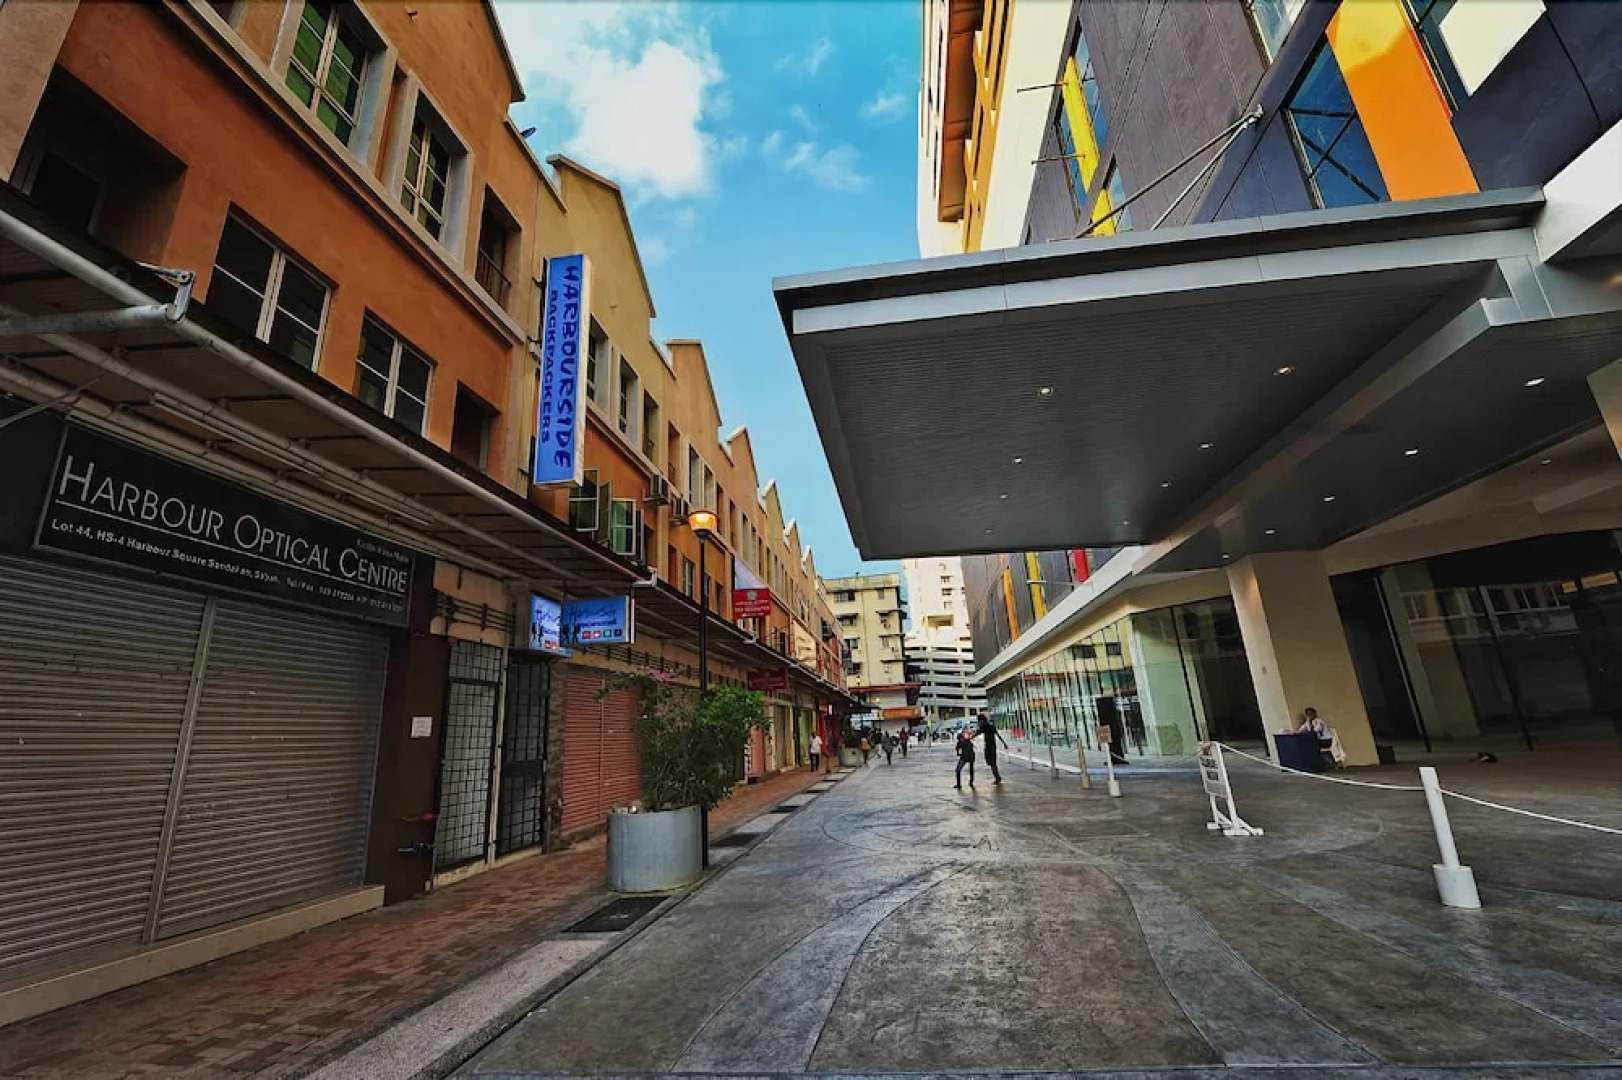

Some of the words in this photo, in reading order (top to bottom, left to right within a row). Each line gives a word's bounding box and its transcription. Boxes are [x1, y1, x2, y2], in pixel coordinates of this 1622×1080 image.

[541, 289, 559, 444] BACKPACKERS
[554, 265, 580, 468] HARBOURSIDE
[51, 517, 74, 533] Lot
[75, 523, 94, 540] 44,
[96, 529, 125, 546] HS-4
[126, 536, 171, 559] Harbour
[171, 548, 208, 569] Square
[59, 455, 225, 541] HARBOUR
[234, 514, 331, 573] OPTICAL
[339, 547, 408, 593] CENTRE
